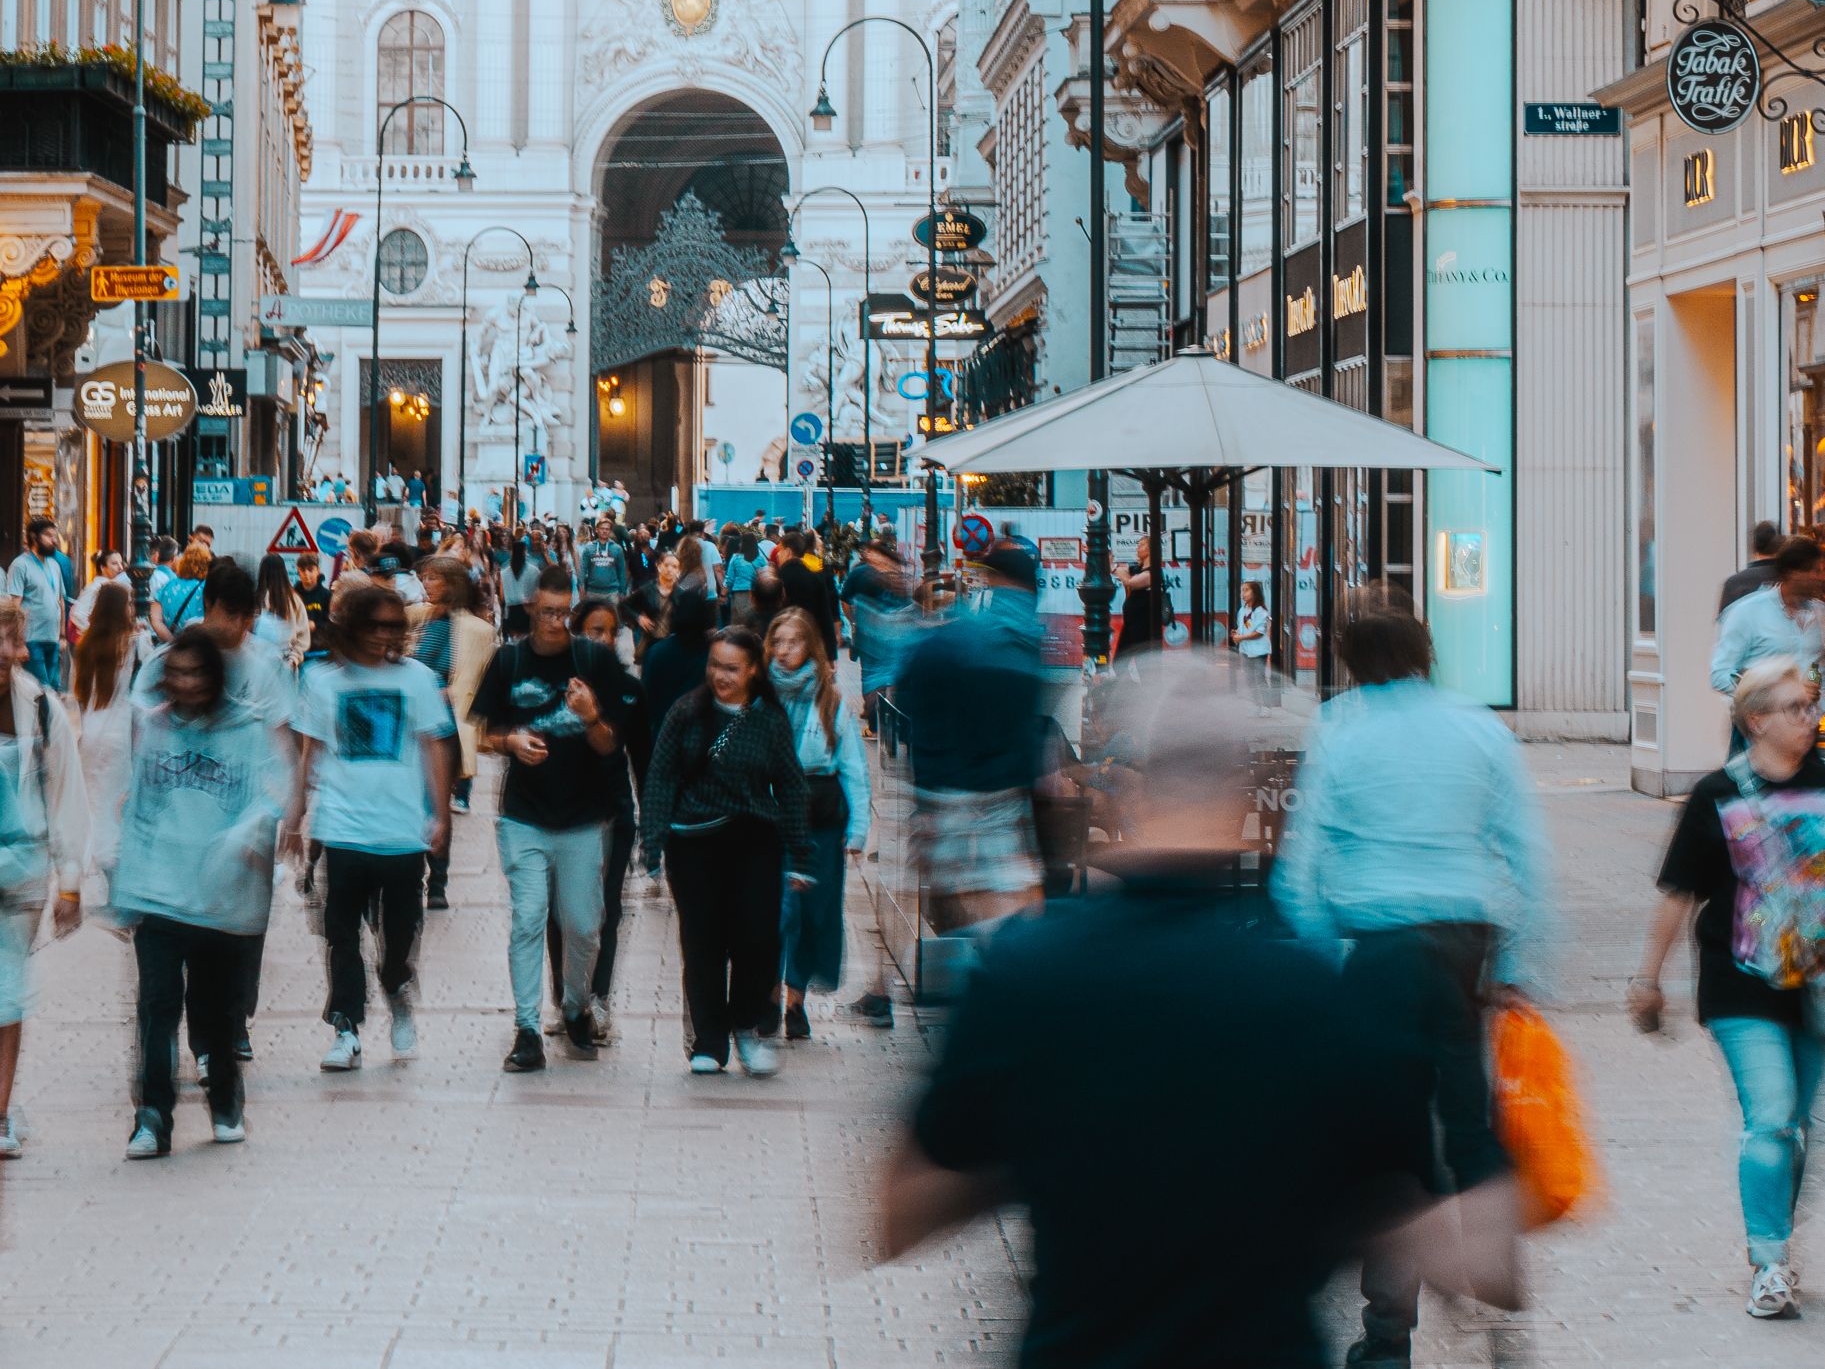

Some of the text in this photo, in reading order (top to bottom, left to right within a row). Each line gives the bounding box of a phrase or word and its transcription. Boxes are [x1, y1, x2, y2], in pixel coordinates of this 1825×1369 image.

[1676, 44, 1751, 78] Tabak
[1676, 75, 1751, 107] Trafik
[1555, 120, 1590, 134] straße
[110, 271, 163, 283] Museum der
[115, 284, 160, 296] Illusionen
[265, 300, 369, 321] APOTHEKE
[81, 381, 117, 408] GS
[119, 387, 191, 401] Intnational
[162, 401, 184, 417] Art
